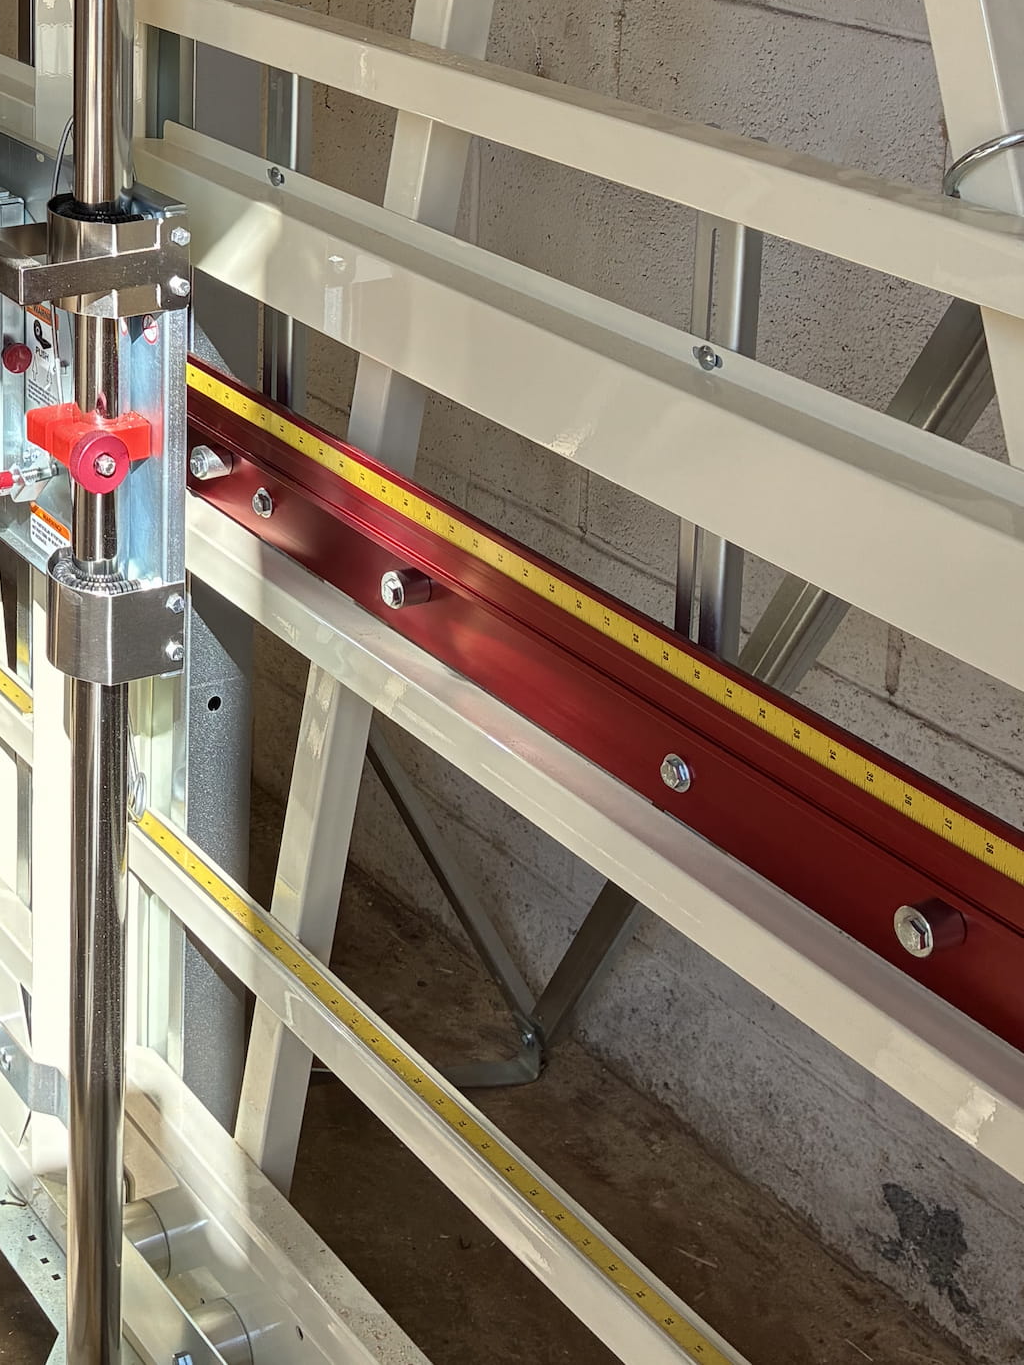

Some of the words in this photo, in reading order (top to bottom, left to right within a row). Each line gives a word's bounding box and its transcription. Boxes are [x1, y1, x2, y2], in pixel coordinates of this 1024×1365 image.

[35, 346, 50, 361] PUSH
[694, 669, 701, 680] 30
[725, 687, 733, 698] 31
[759, 707, 766, 719] 32
[793, 728, 801, 740] 33
[829, 748, 837, 761] 34
[866, 771, 874, 783] 35
[904, 793, 913, 807] 36
[944, 817, 953, 830] 37
[985, 842, 994, 855] 38
